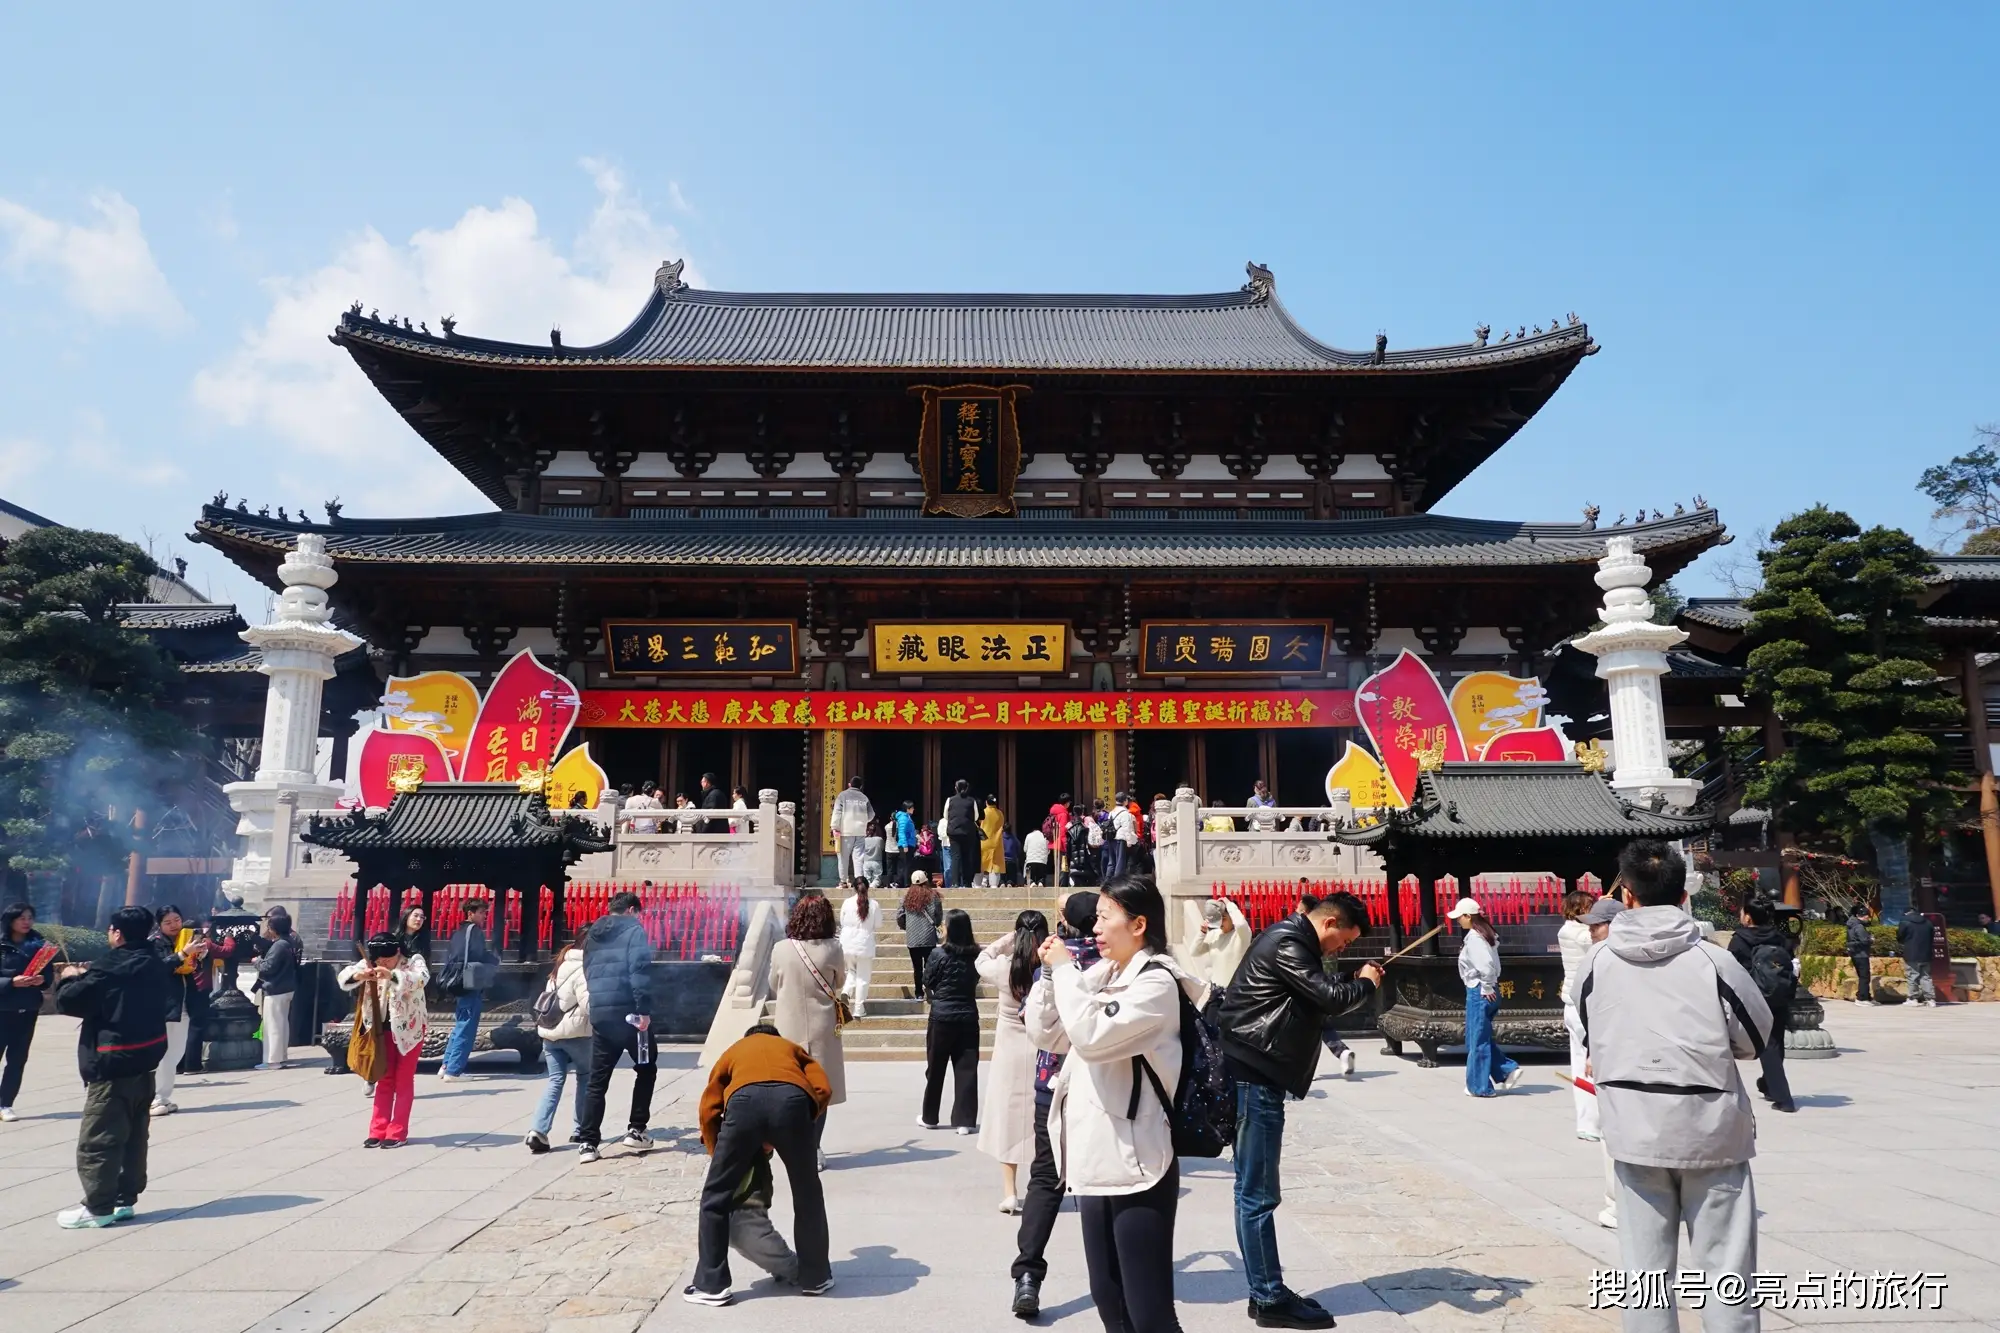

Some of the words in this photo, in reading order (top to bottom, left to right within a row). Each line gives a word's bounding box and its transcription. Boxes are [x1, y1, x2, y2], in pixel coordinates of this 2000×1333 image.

[956, 401, 984, 492] 釋迦寶殿
[896, 633, 1051, 662] 正法眼藏
[618, 698, 710, 724] 大慈大悲
[722, 698, 816, 724] 廣大靈感
